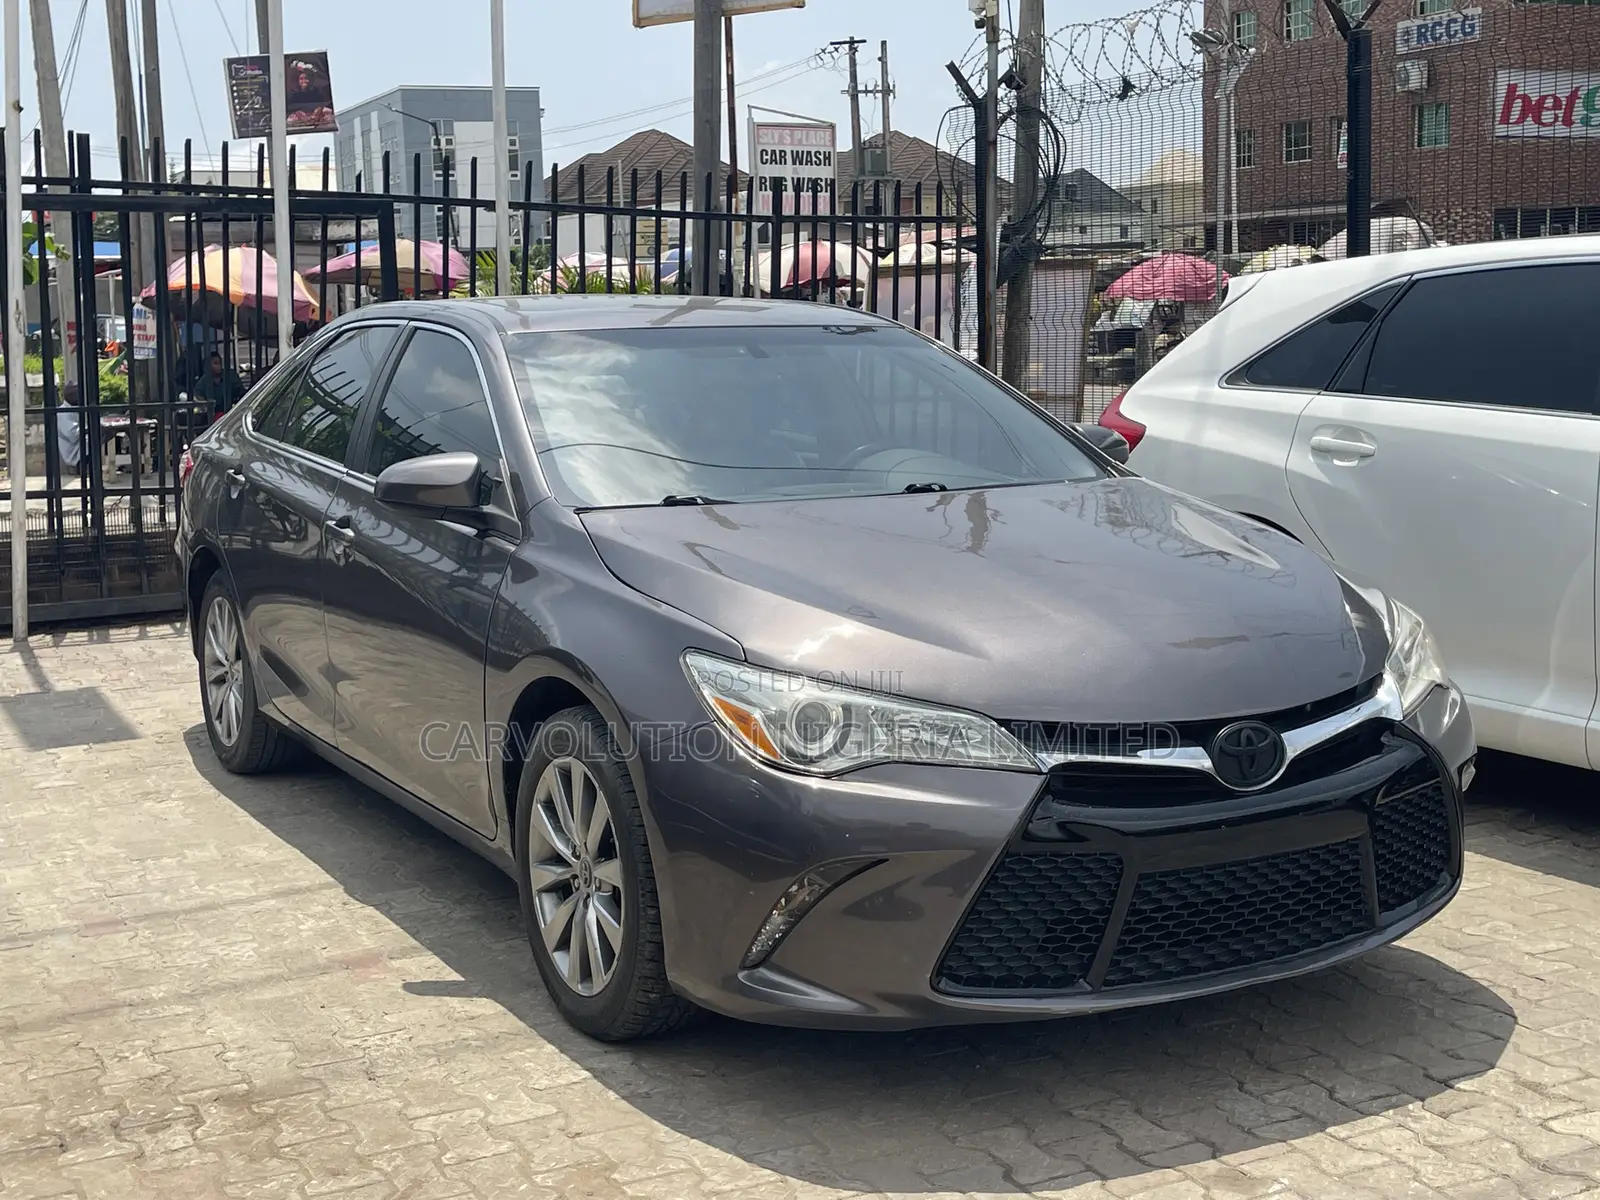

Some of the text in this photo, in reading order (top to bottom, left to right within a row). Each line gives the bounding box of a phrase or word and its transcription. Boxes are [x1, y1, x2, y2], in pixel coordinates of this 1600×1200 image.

[1416, 15, 1477, 45] RCCG
[793, 130, 833, 146] PLACE
[760, 149, 832, 167] CAR WASH
